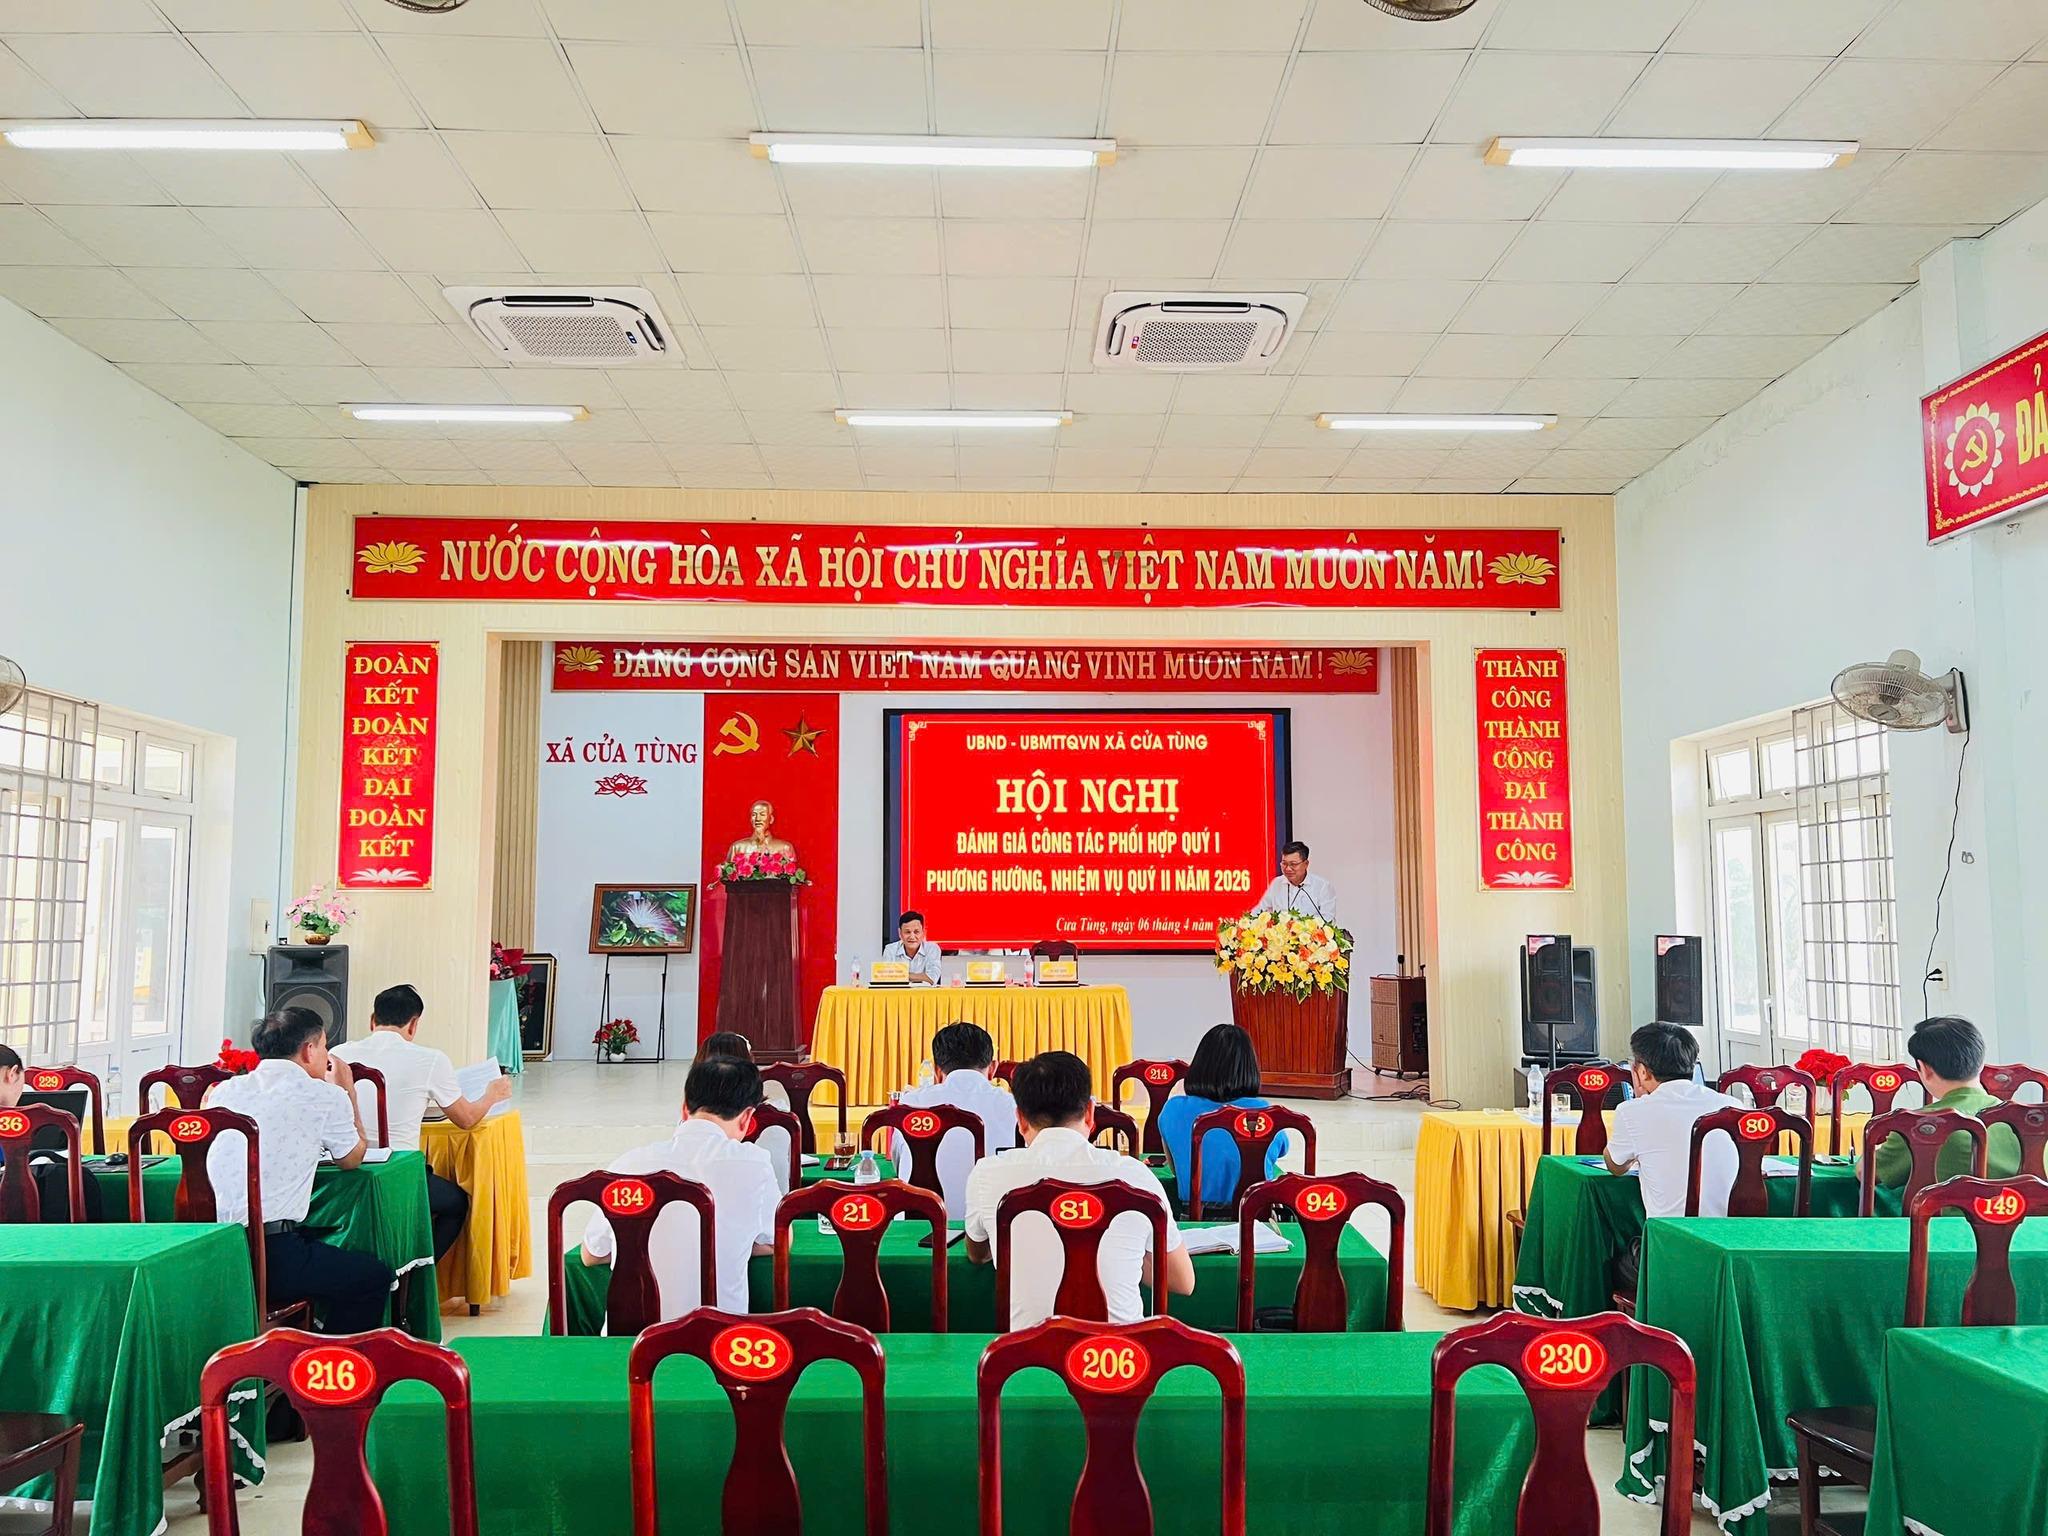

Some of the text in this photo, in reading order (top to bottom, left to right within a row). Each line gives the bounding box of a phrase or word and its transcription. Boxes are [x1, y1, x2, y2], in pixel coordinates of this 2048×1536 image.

[441, 523, 1484, 605] NƯỚC CỘNG HÒA XÃ HỘI CHỦ NGHĨA VIỆT NAM MUÔN NĂM!
[353, 651, 431, 675] ĐOÀN
[920, 650, 982, 679] NAM
[989, 650, 1081, 681] QUANG
[1085, 651, 1157, 680] VINH
[1483, 655, 1559, 678] THÀNH
[363, 679, 419, 705] KẾT
[1491, 686, 1552, 708] CÔNG
[351, 712, 429, 736] ĐOÀN
[1484, 715, 1560, 739] THÀNH
[545, 733, 698, 764] XÃ CỬA TÙNG
[966, 735, 1007, 750] UBND
[1020, 735, 1100, 750] UBMTTQVN
[1105, 731, 1126, 750] XÃ
[1130, 729, 1163, 750] CỬA
[1168, 731, 1208, 750] TÙNG
[361, 740, 417, 766] KẾT
[1493, 746, 1553, 769] CÔNG
[363, 778, 413, 800] ĐẠI
[996, 768, 1179, 822] HỘI NGHỊ
[1505, 781, 1547, 804] ĐẠI
[348, 803, 426, 827] ĐOÀN
[1487, 807, 1564, 830] THÀNH
[358, 831, 414, 858] KẾT
[957, 824, 1220, 859] ĐÁNH GIÁ CÔNG TÁC PHỐI HỢP QUÝ I
[1495, 838, 1557, 861] CÔNG
[926, 865, 1250, 896] PHƯƠNG HƯỚNG, NHIỆM VỤ QUÝ II NĂM 2026
[1138, 917, 1150, 932] 06
[1152, 917, 1181, 935] tháng
[1183, 917, 1190, 931] 4
[38, 1075, 59, 1088] 229
[1150, 1069, 1169, 1081] 214
[1584, 1074, 1604, 1086] 135
[1876, 1074, 1896, 1087] 69
[177, 1120, 202, 1137] 22
[911, 1117, 934, 1131] 29
[1745, 1117, 1770, 1134] 80
[611, 1188, 644, 1207] 134
[1305, 1192, 1337, 1212] 94
[1983, 1195, 2018, 1215] 149
[843, 1202, 870, 1223] 21
[1059, 1200, 1092, 1220] 81
[729, 1337, 776, 1369] 83
[1083, 1347, 1136, 1379] 206
[1540, 1343, 1592, 1374] 230
[307, 1360, 356, 1391] 216
